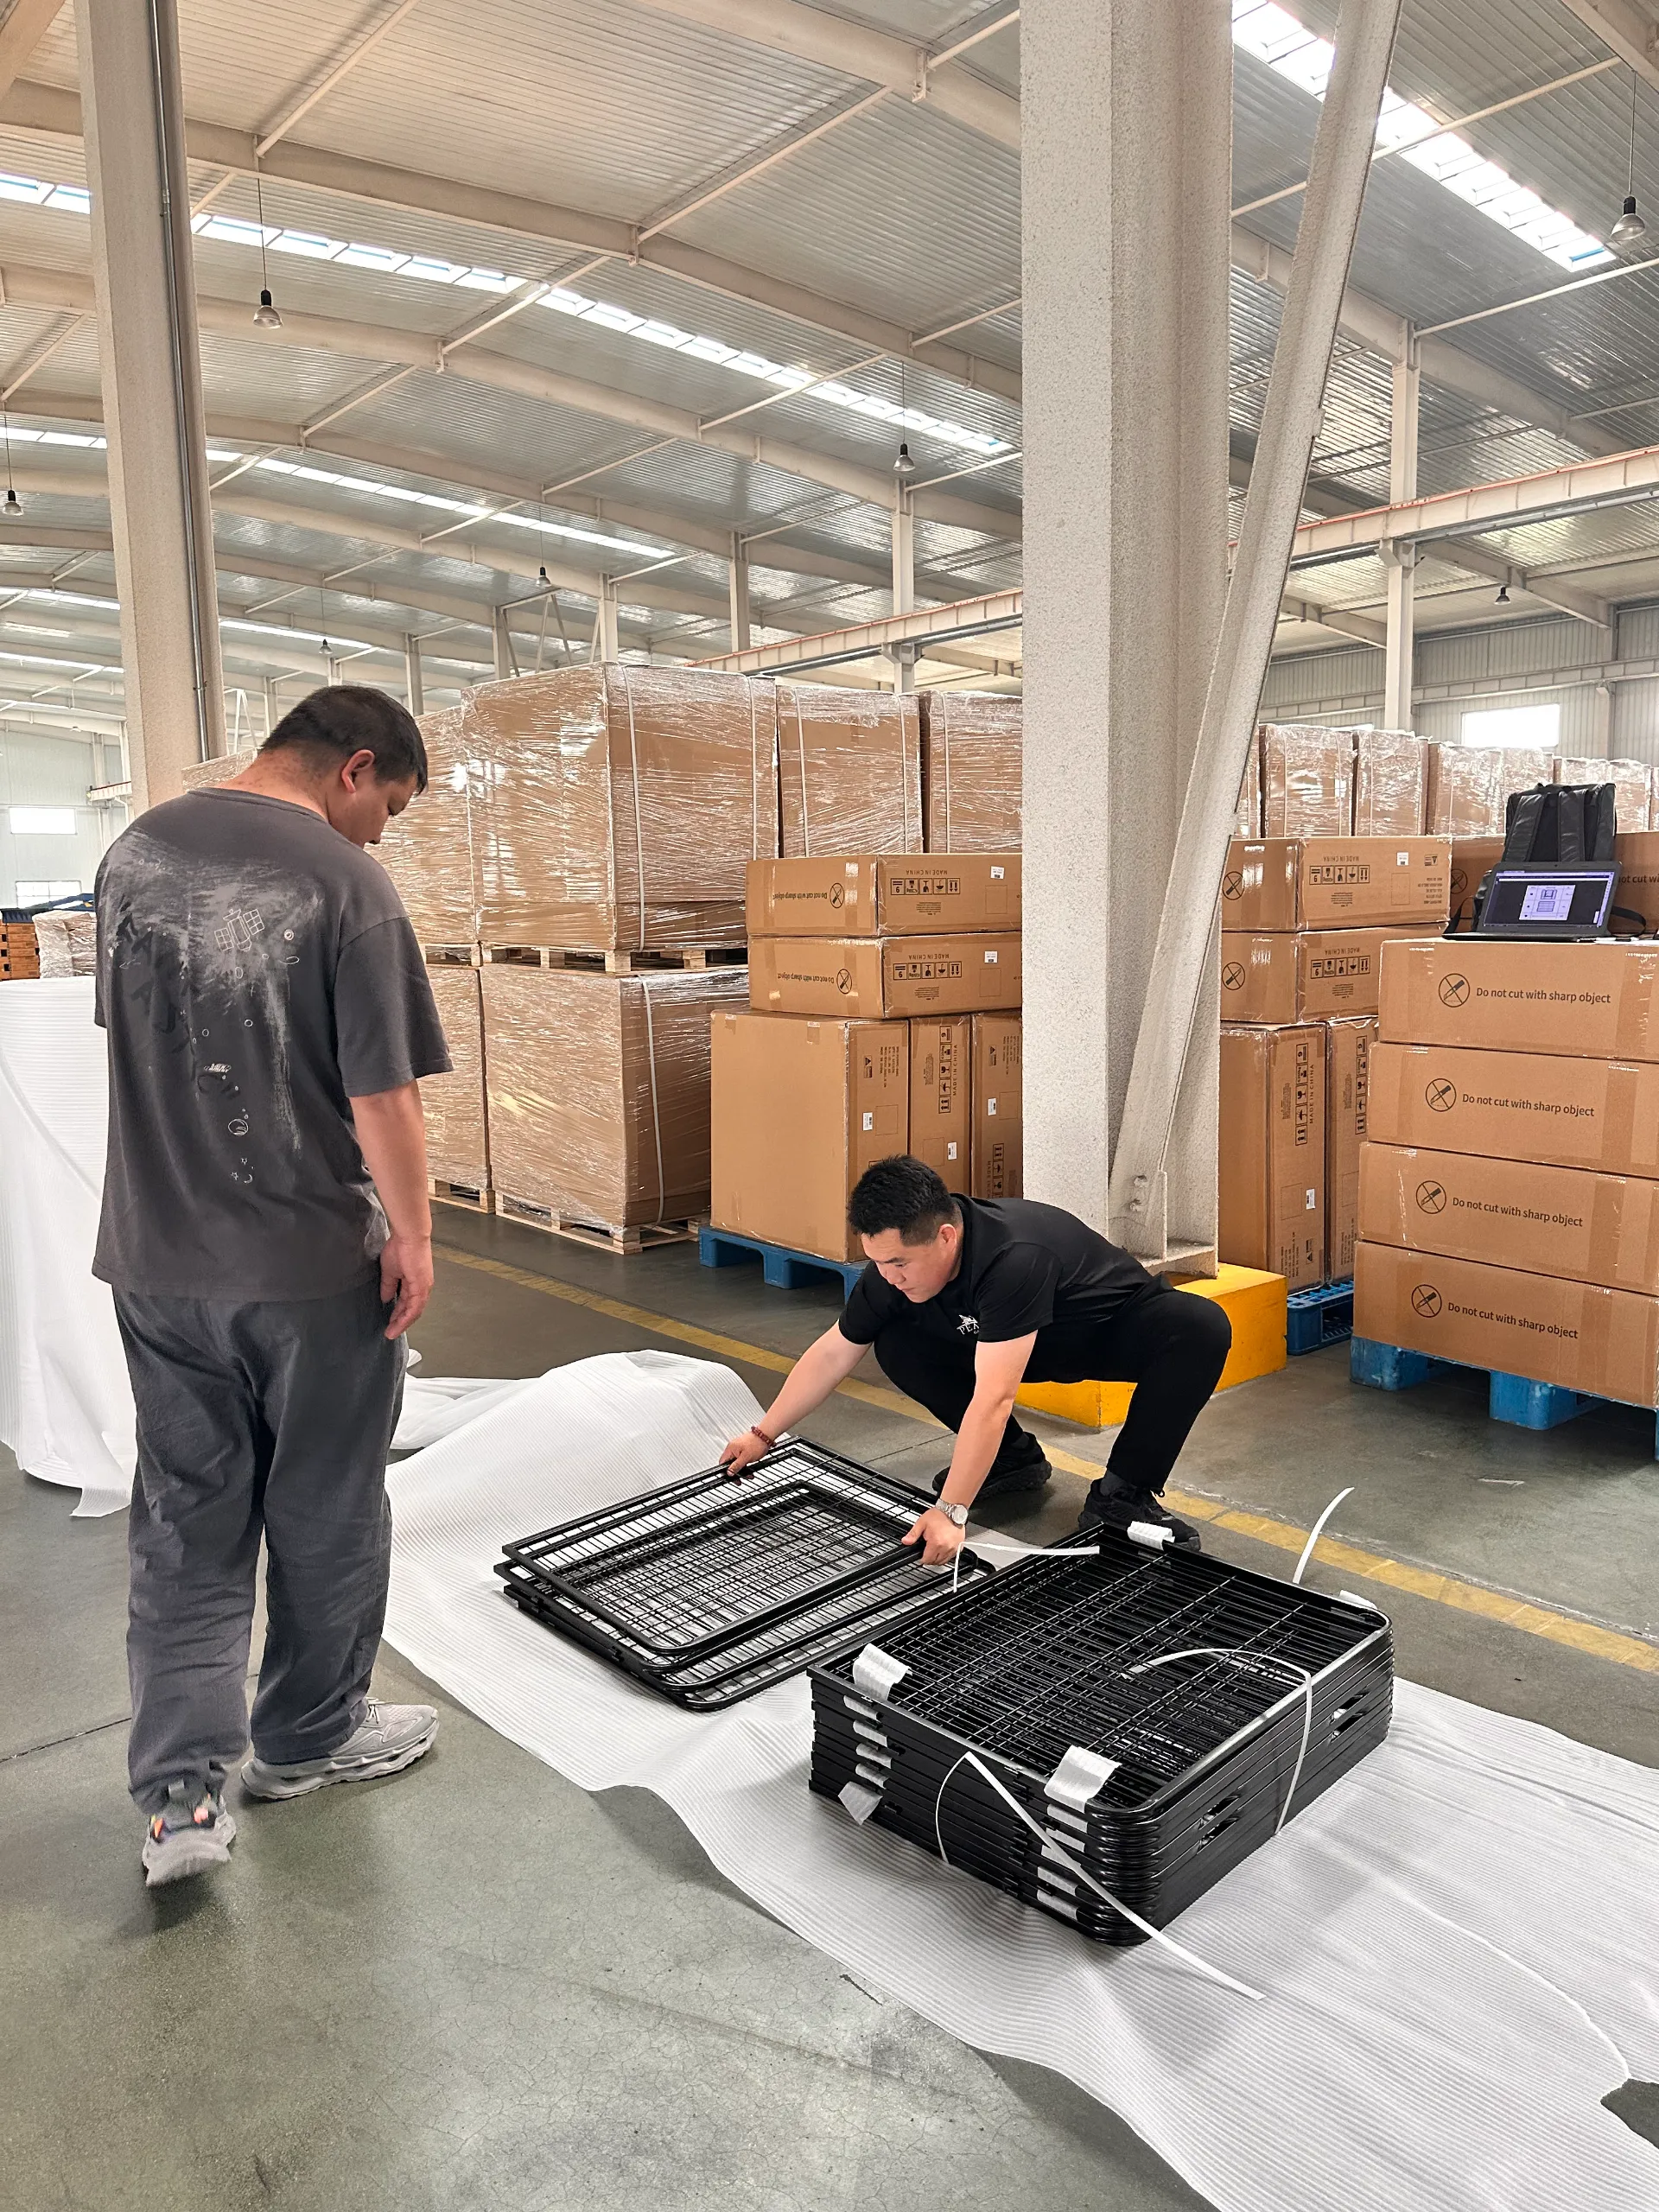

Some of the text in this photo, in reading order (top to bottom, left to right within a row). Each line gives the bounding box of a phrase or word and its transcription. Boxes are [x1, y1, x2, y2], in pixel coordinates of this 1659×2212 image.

[1632, 874, 1647, 883] cut
[1649, 873, 1659, 883] wi
[1476, 988, 1611, 1005] Do not cut with sharp object
[1310, 1091, 1313, 1100] IN
[1462, 1094, 1595, 1117] Do not cut with sharp object
[1452, 1198, 1583, 1227] Do not cut with sharp object
[1448, 1302, 1578, 1338] Do not cut with sharp object
